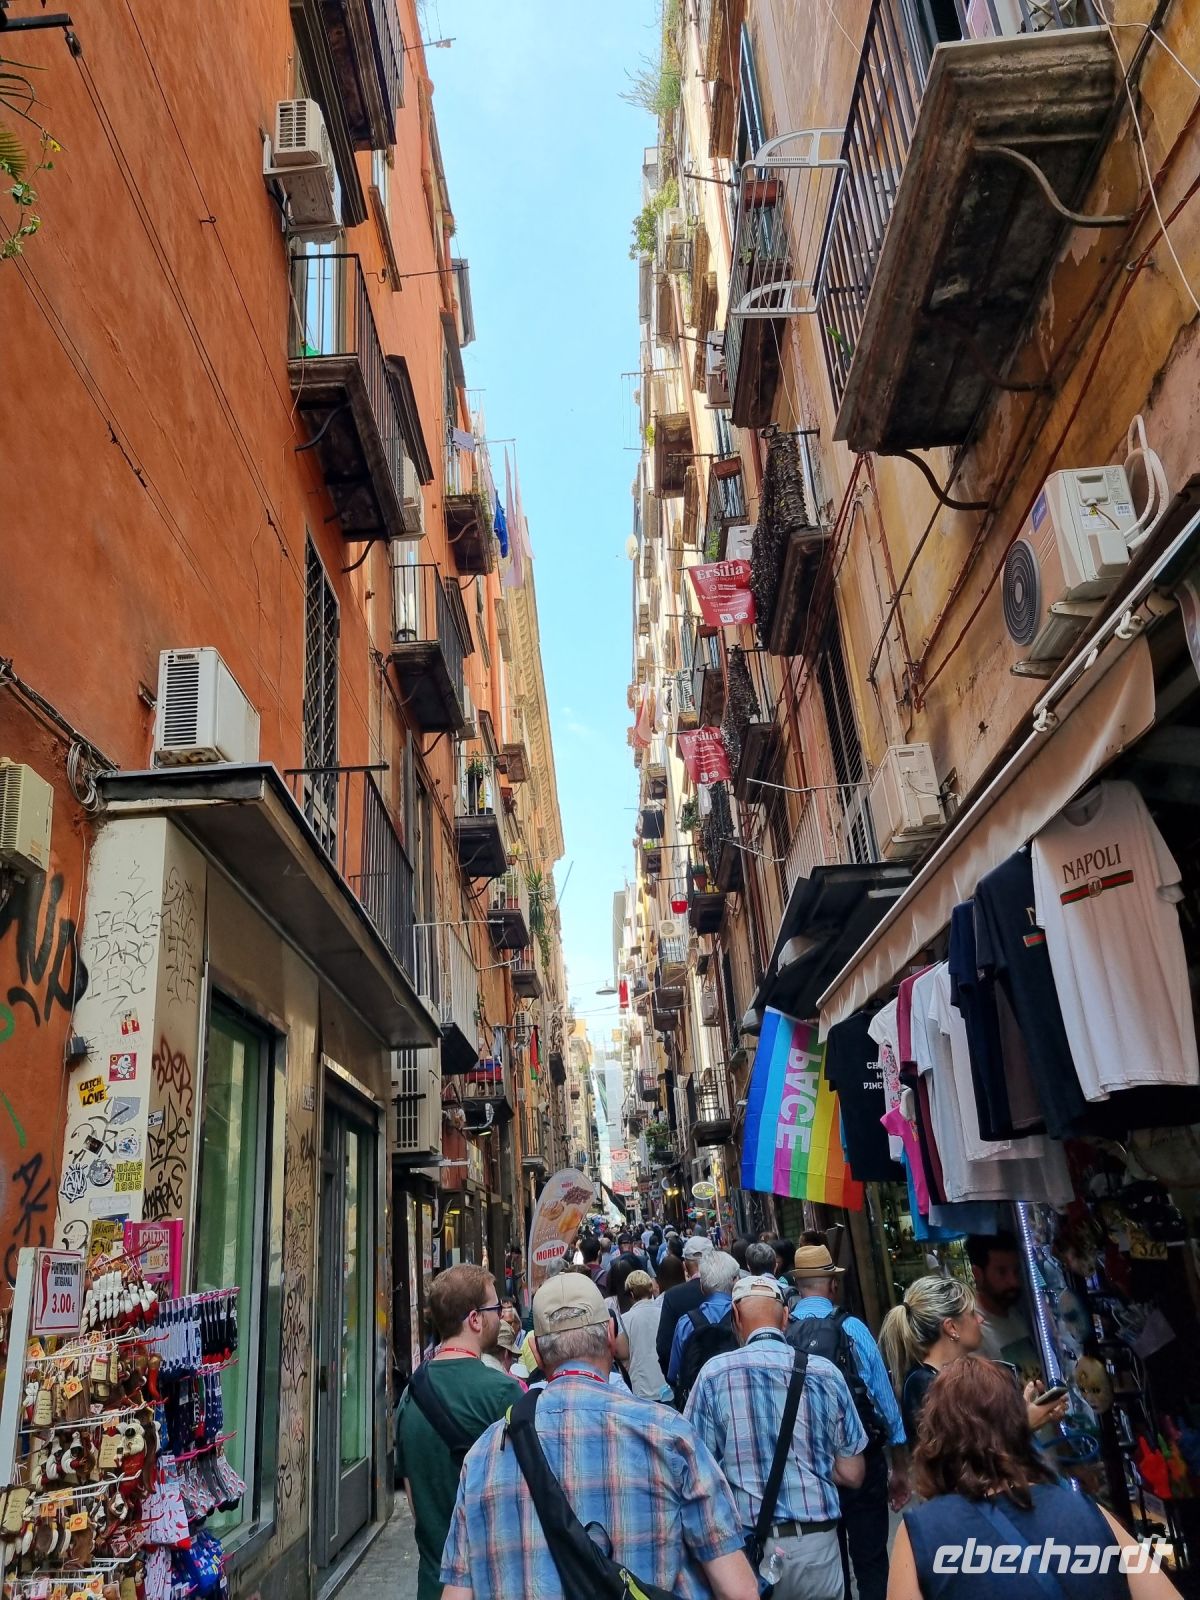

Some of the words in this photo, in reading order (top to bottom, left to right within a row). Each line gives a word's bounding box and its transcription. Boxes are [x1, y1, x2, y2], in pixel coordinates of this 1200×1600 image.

[696, 564, 745, 580] Ersilia
[1062, 844, 1122, 884] NAPOLI
[80, 1077, 102, 1091] CATCH
[82, 1089, 105, 1106] LOVE
[776, 1047, 822, 1153] PACE
[115, 1181, 142, 1193] 1995
[536, 1245, 565, 1262] MORENO
